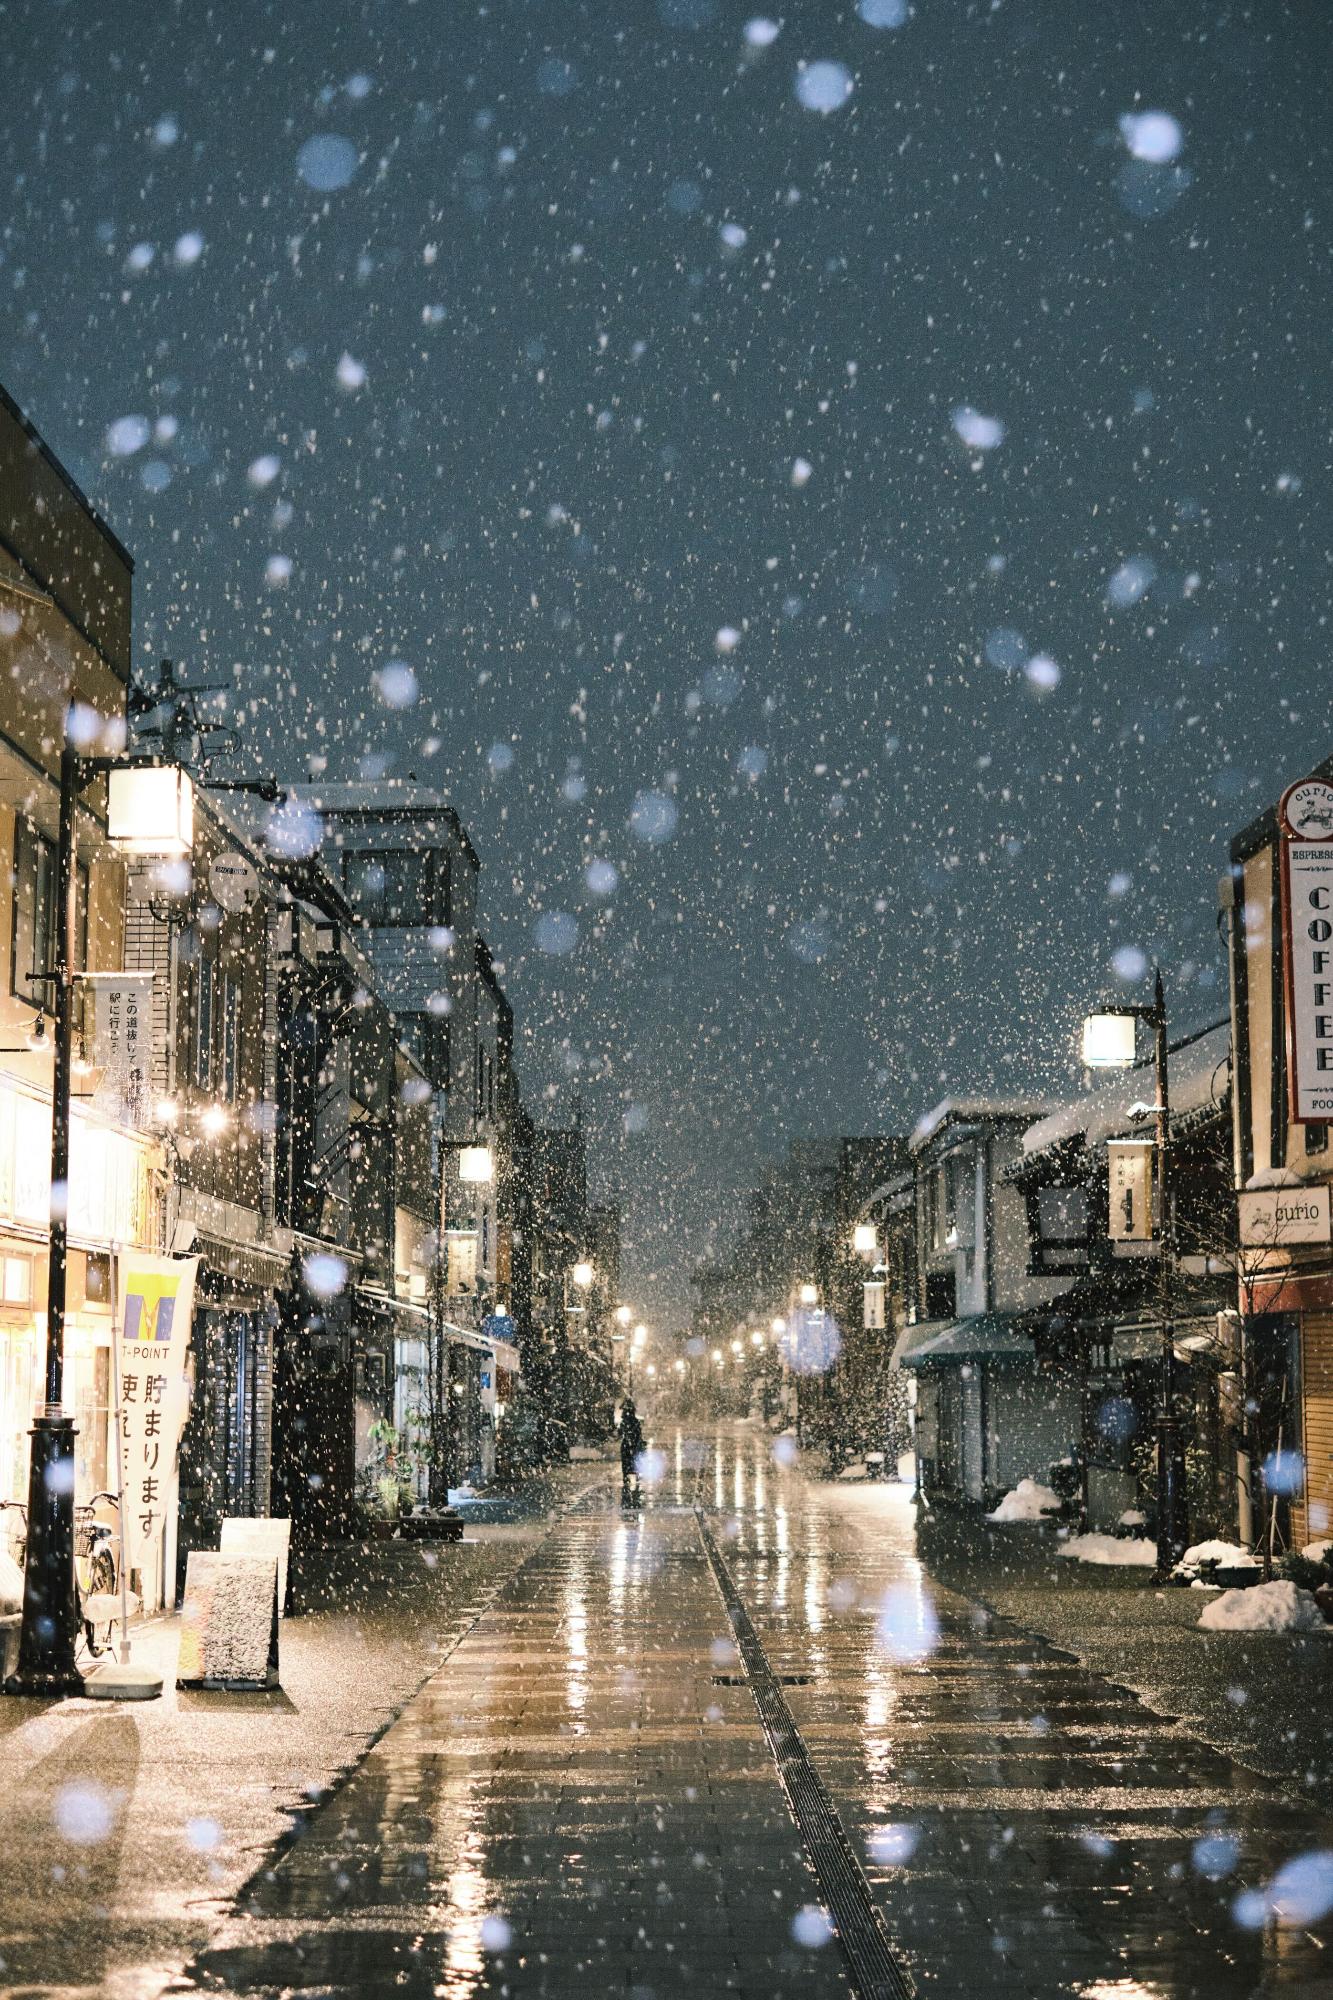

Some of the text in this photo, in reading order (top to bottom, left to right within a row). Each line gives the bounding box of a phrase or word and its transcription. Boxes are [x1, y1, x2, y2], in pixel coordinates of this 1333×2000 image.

[1295, 787, 1333, 802] curio
[1308, 887, 1333, 1071] COFFEE
[1275, 1203, 1319, 1222] curio
[122, 1346, 170, 1359] T-POINT
[139, 1374, 167, 1539] 貯まります
